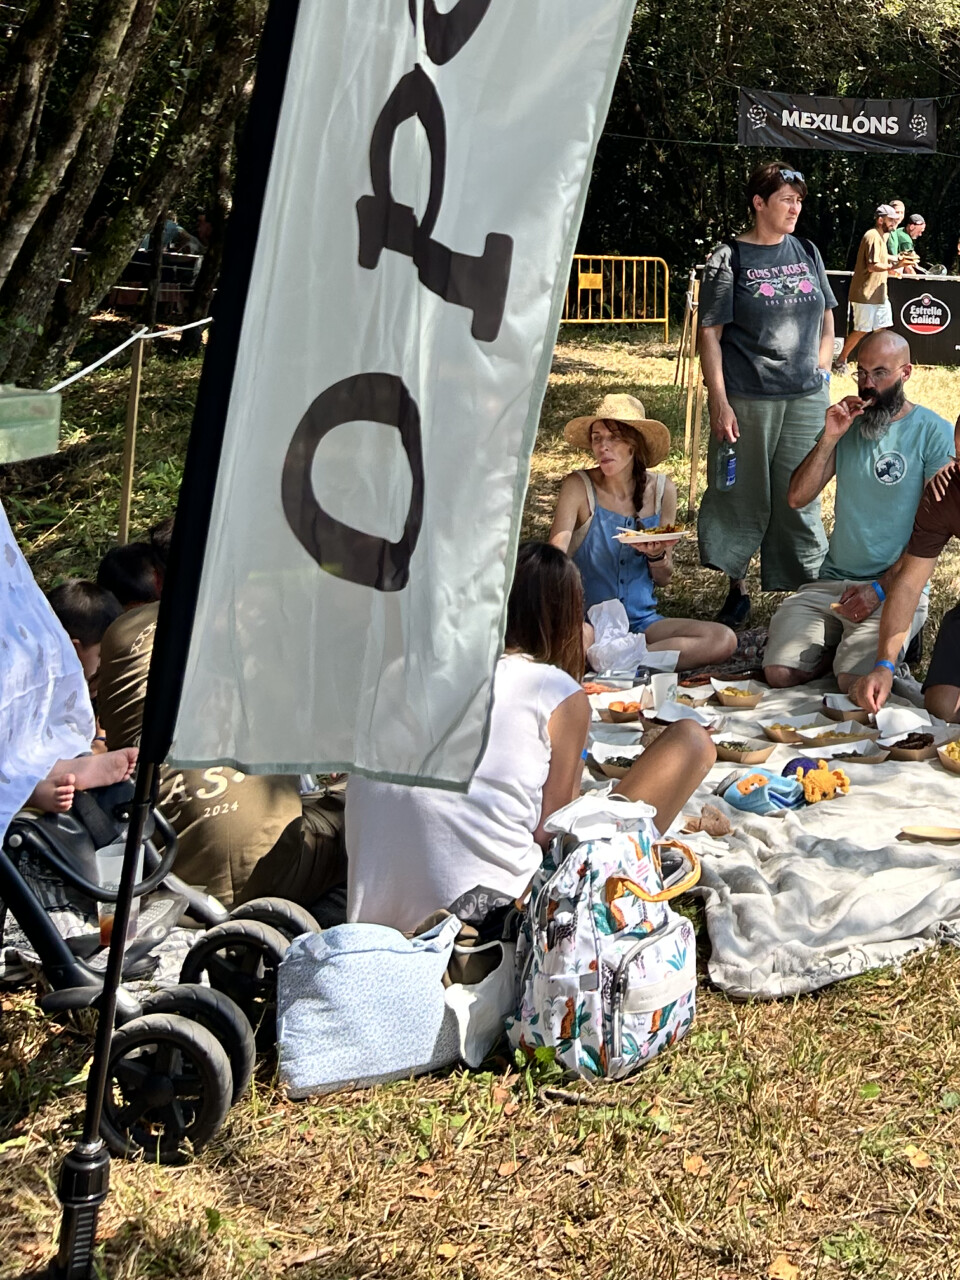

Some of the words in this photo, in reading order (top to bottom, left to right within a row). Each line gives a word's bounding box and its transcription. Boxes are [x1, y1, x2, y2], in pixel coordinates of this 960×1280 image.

[781, 110, 899, 135] MEXILLÓNS
[747, 269, 771, 279] GUNS
[781, 262, 809, 275] ROSES
[909, 305, 942, 316] Estrella
[910, 314, 940, 325] Galicia
[203, 801, 239, 818] 2024
